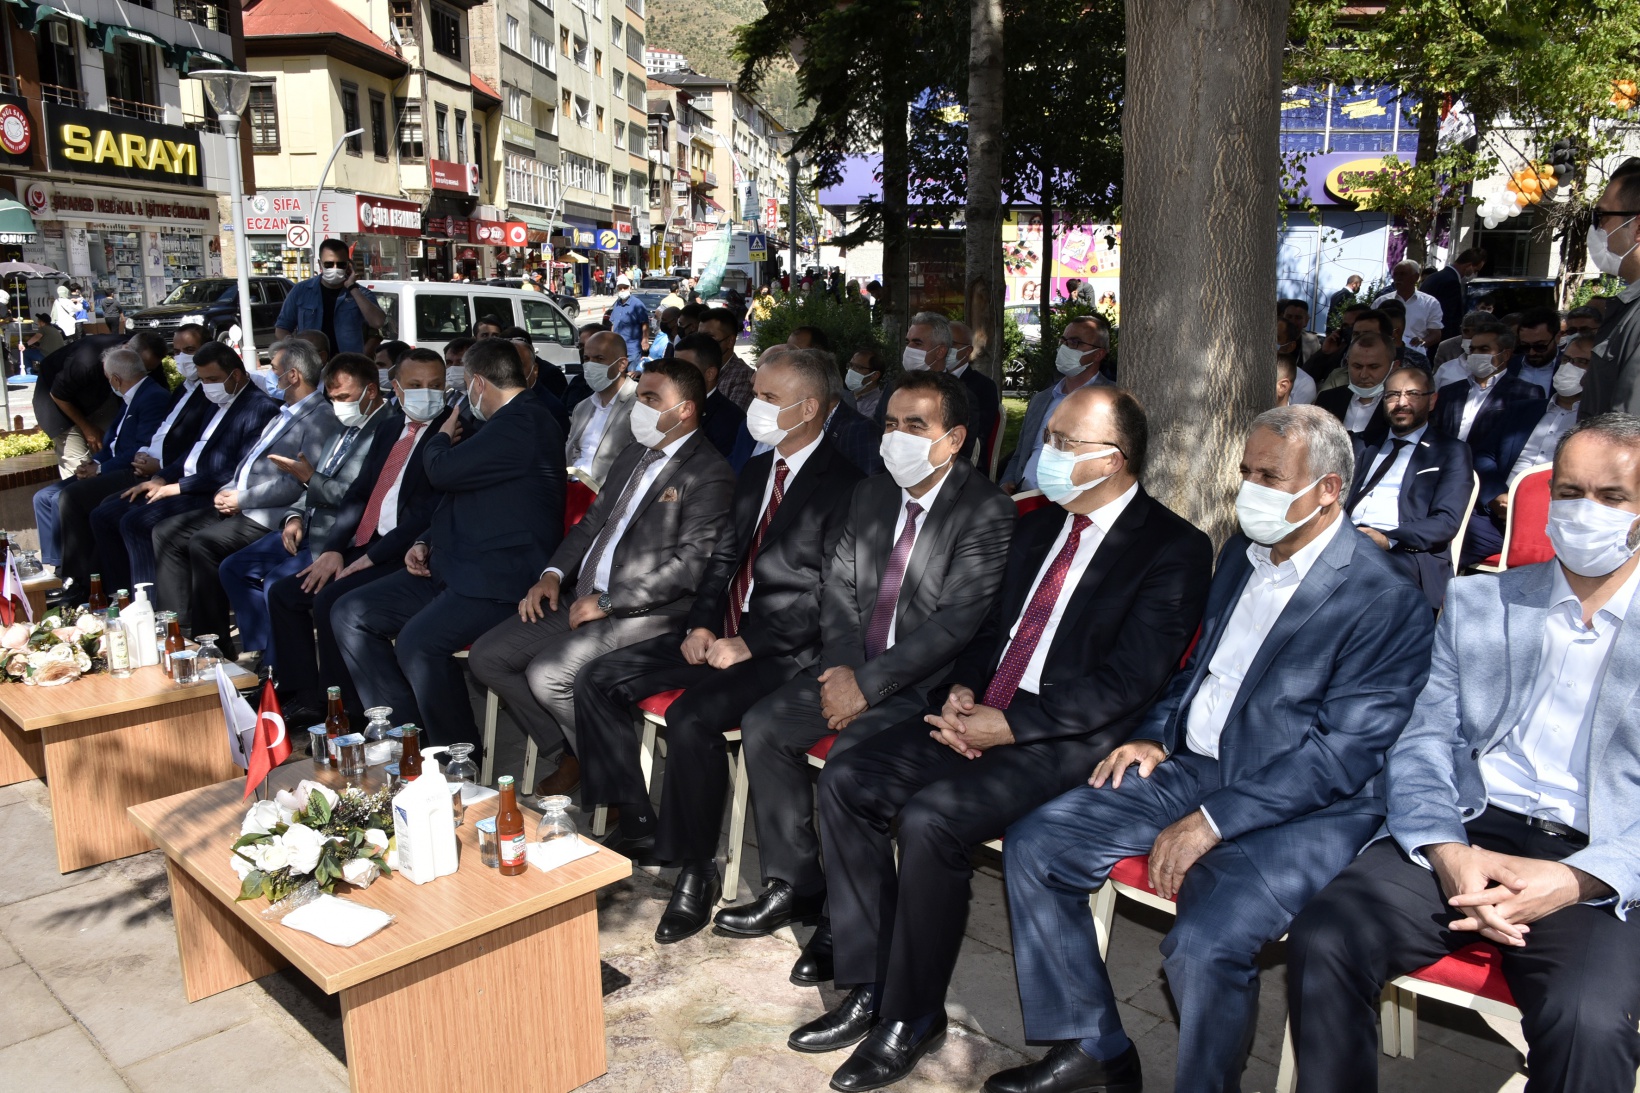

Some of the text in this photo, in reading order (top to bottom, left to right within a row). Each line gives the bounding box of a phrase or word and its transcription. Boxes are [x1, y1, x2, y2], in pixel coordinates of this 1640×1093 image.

[63, 124, 198, 176] SARAYI
[273, 196, 301, 213] ŞİFA
[247, 214, 309, 230] ECZANİ
